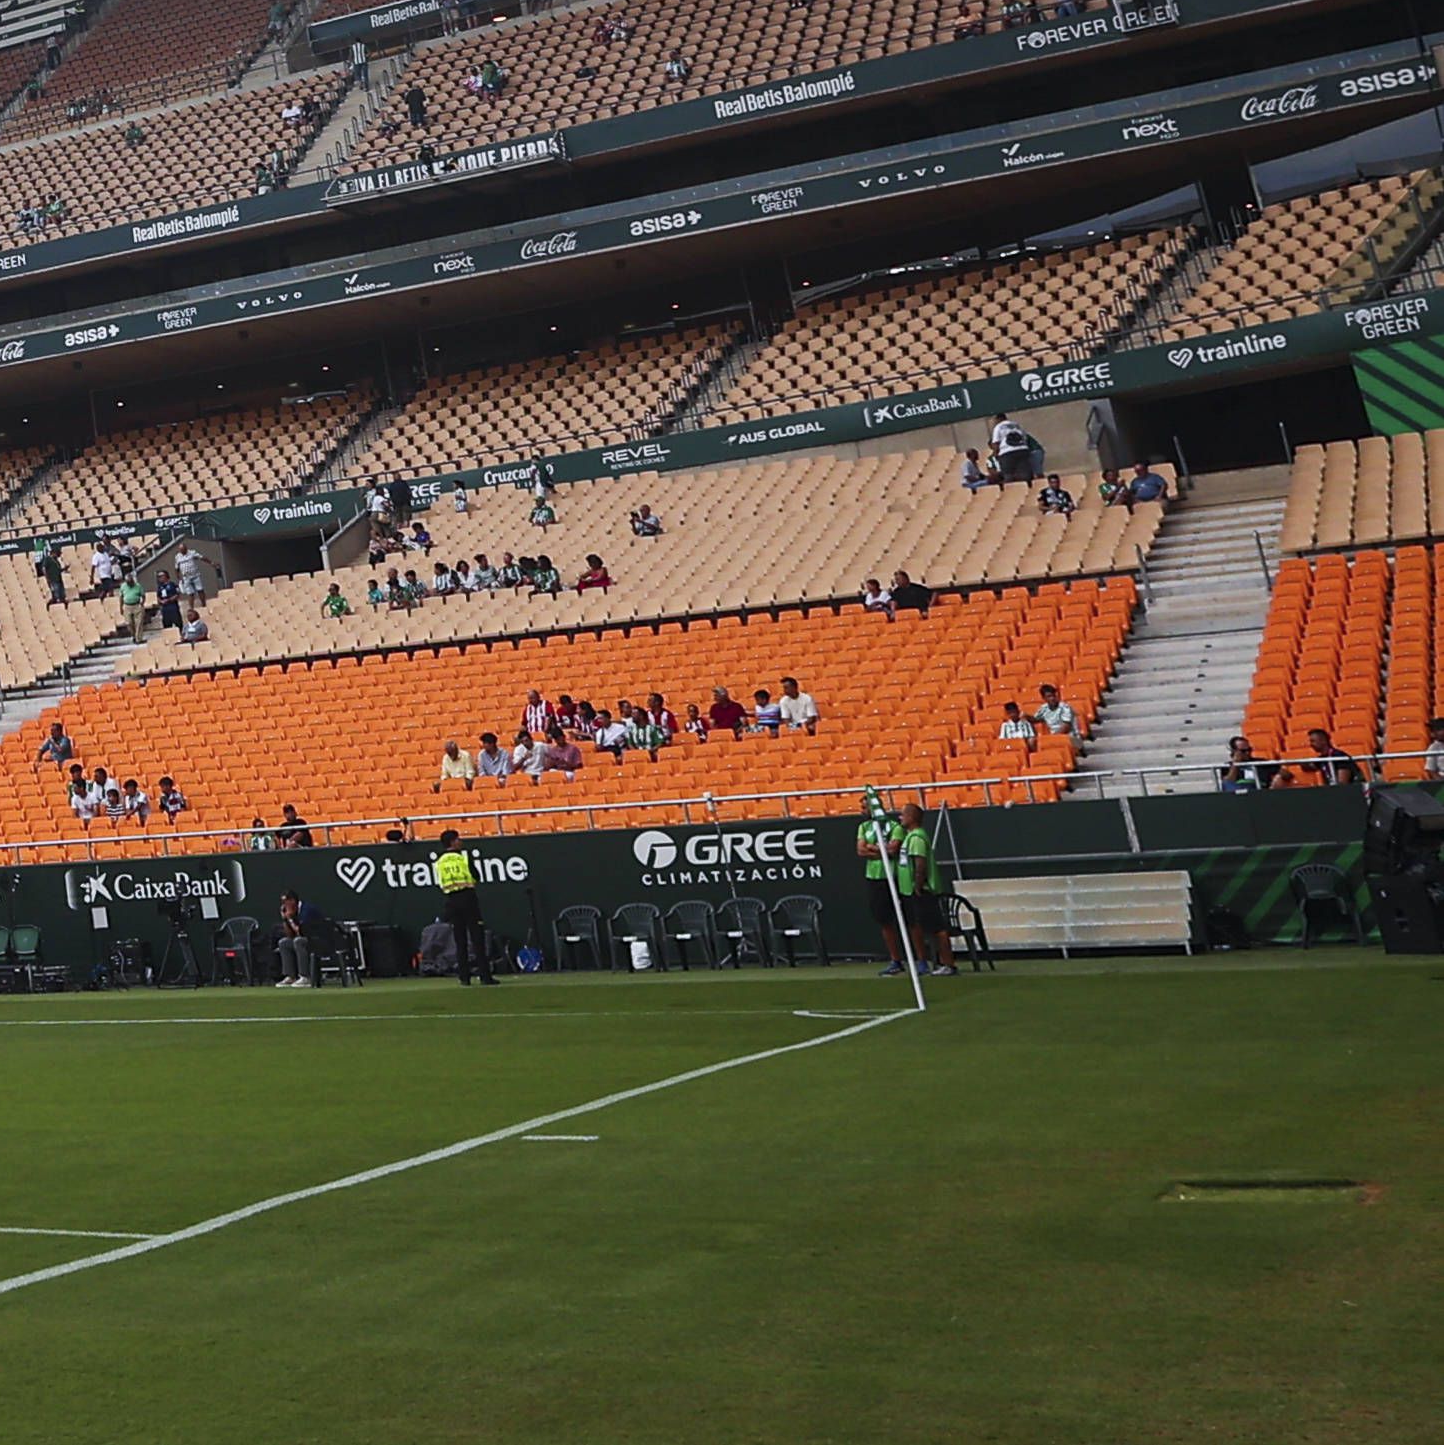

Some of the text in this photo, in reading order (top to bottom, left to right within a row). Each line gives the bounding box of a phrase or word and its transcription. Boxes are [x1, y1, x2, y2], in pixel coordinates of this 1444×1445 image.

[1017, 19, 1107, 51] FOREVER
[1341, 68, 1415, 97] asisa
[715, 70, 855, 119] Real Betis Balompié
[1122, 119, 1178, 140] next
[1003, 151, 1044, 168] Halcón
[859, 164, 945, 188] VOLVO
[752, 186, 804, 205] FOREVER
[762, 199, 798, 213] GREEN
[133, 206, 239, 244] Real Betis Balompié
[630, 212, 686, 236] asisa
[434, 256, 474, 273] next
[238, 291, 302, 310] VOLVO
[1345, 298, 1428, 326] FOREVER
[158, 307, 197, 323] FOREVER
[165, 317, 193, 329] GREEN
[65, 325, 107, 347] asisa
[1362, 317, 1420, 340] GREEN
[1197, 334, 1286, 364] trainline
[1047, 363, 1110, 388] GREE
[893, 395, 963, 420] CaixaBank
[739, 421, 825, 444] AUS GLOBAL
[602, 444, 670, 465] REVEL
[484, 464, 554, 485] Cruzcao
[409, 482, 441, 498] REE
[273, 501, 332, 522] trainline
[685, 828, 815, 865] GREE
[382, 849, 528, 888] trailine
[642, 864, 822, 886] CLIMATIZACIÓN
[113, 870, 230, 901] CaixaBank
